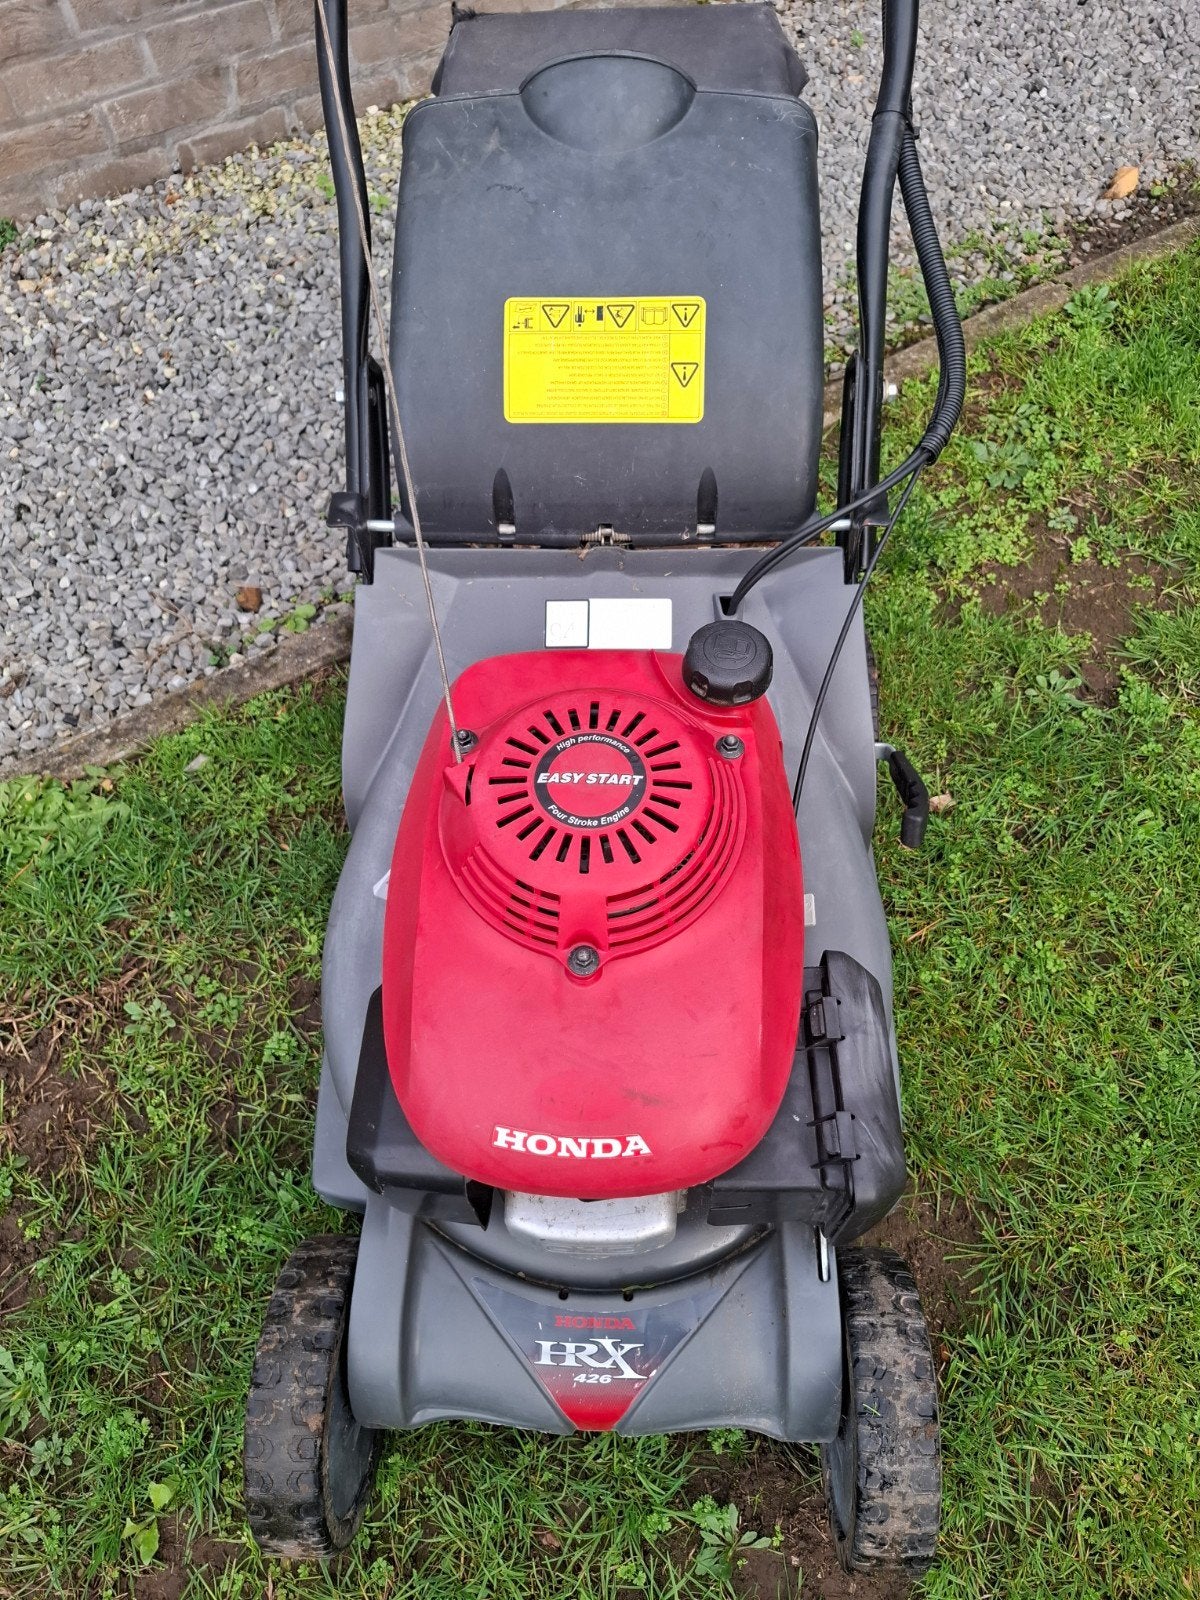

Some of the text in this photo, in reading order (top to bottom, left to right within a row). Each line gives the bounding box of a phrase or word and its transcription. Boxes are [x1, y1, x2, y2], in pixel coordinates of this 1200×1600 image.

[555, 734, 631, 754] High performance
[537, 772, 644, 786] EASY START
[547, 804, 630, 827] Four Stroke Engine
[493, 1126, 652, 1158] HONDA
[554, 1315, 636, 1330] HONDA
[533, 1338, 648, 1379] HRX
[573, 1373, 612, 1384] 426
